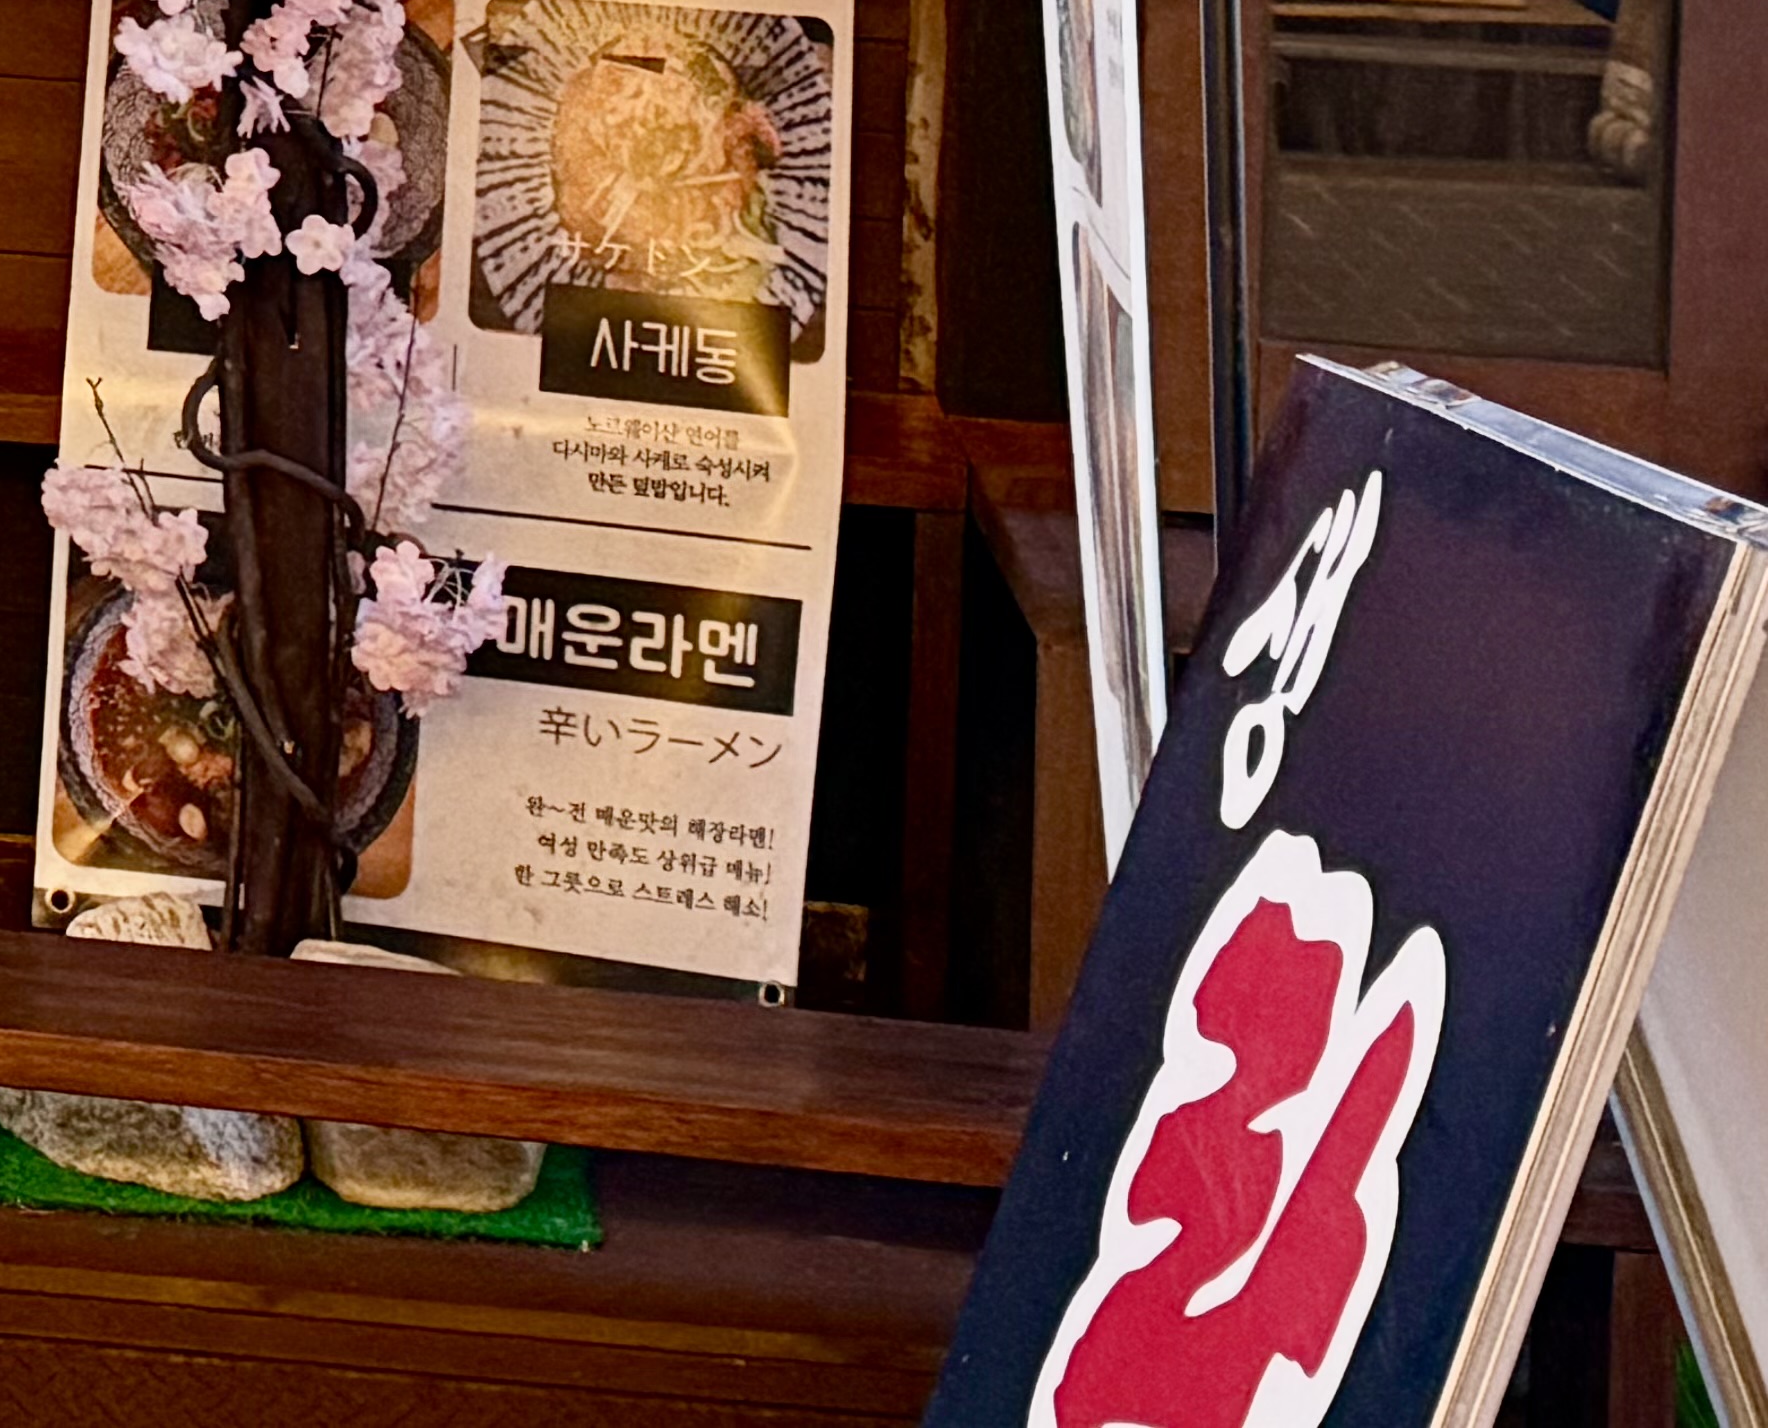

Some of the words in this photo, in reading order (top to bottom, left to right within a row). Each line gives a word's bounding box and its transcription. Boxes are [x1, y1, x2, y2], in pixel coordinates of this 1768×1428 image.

[590, 317, 738, 385] 사케동
[553, 440, 628, 464] 다시마와
[633, 448, 690, 471] 사케로
[695, 454, 771, 482] 숙성시켜
[686, 425, 740, 450] 연어를
[588, 471, 628, 494] 만든
[496, 594, 758, 688] 매운라멘
[539, 706, 782, 768] 辛いラーメン
[596, 805, 679, 837] 매운맛의
[688, 818, 775, 850] 해장라멘!
[538, 832, 578, 857] 여성
[587, 840, 650, 865] 만족도
[656, 849, 718, 878] 상위급
[726, 860, 772, 886] 메뉴!
[515, 864, 534, 886] 한
[541, 869, 626, 897] 그릇으로
[632, 883, 716, 911] 스트레스
[723, 894, 769, 922] 해소!
